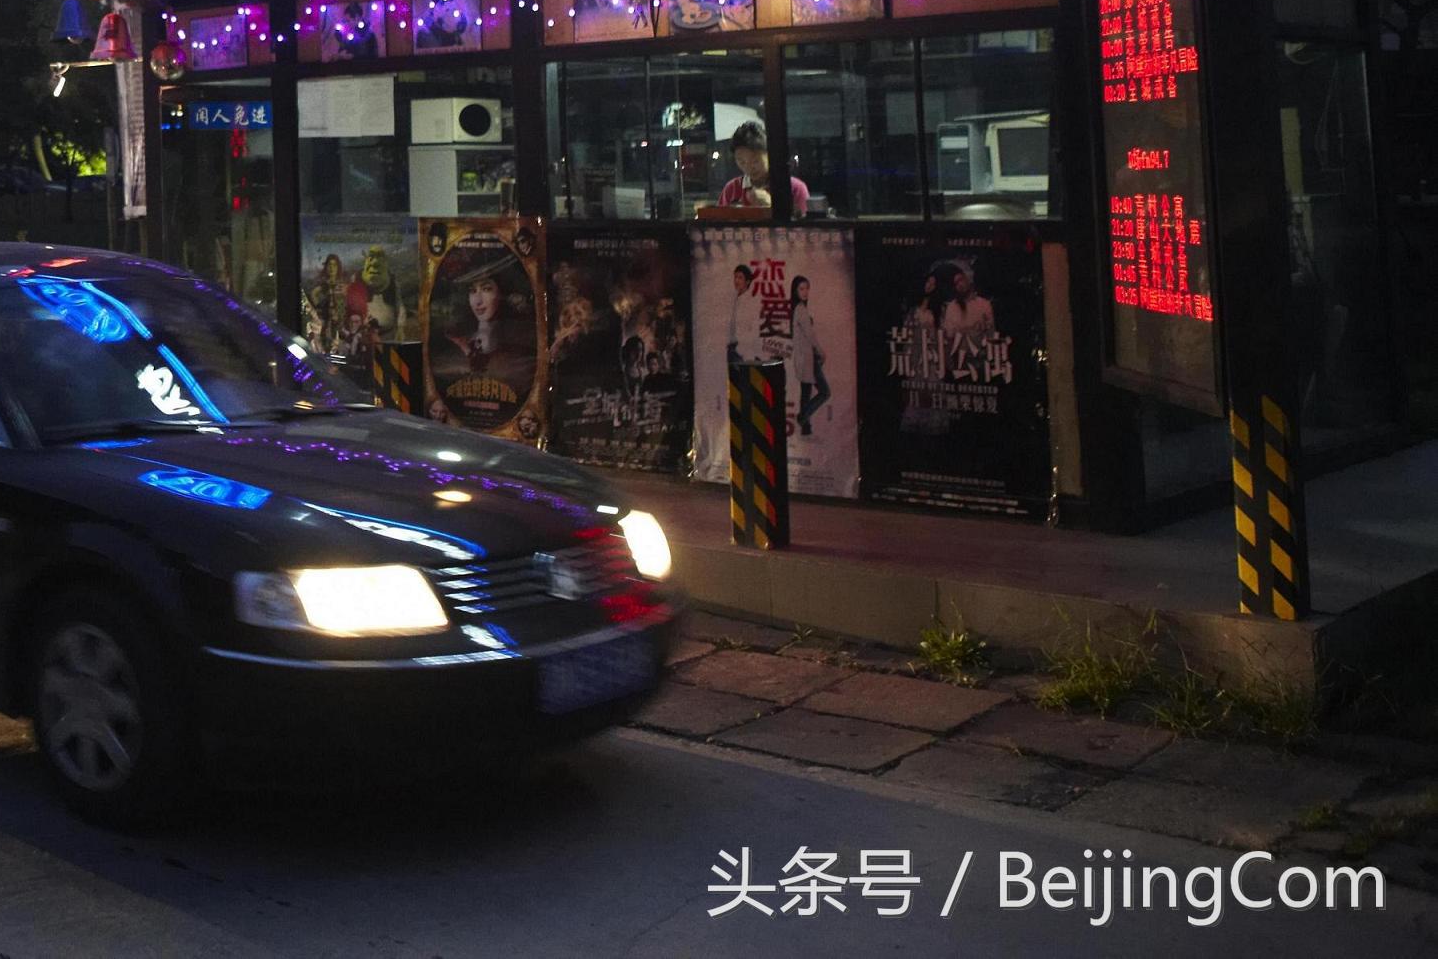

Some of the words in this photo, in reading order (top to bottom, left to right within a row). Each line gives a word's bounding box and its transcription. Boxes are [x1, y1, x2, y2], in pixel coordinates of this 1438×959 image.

[750, 258, 793, 339] 恋爱
[887, 327, 1012, 384] 荒村公寓
